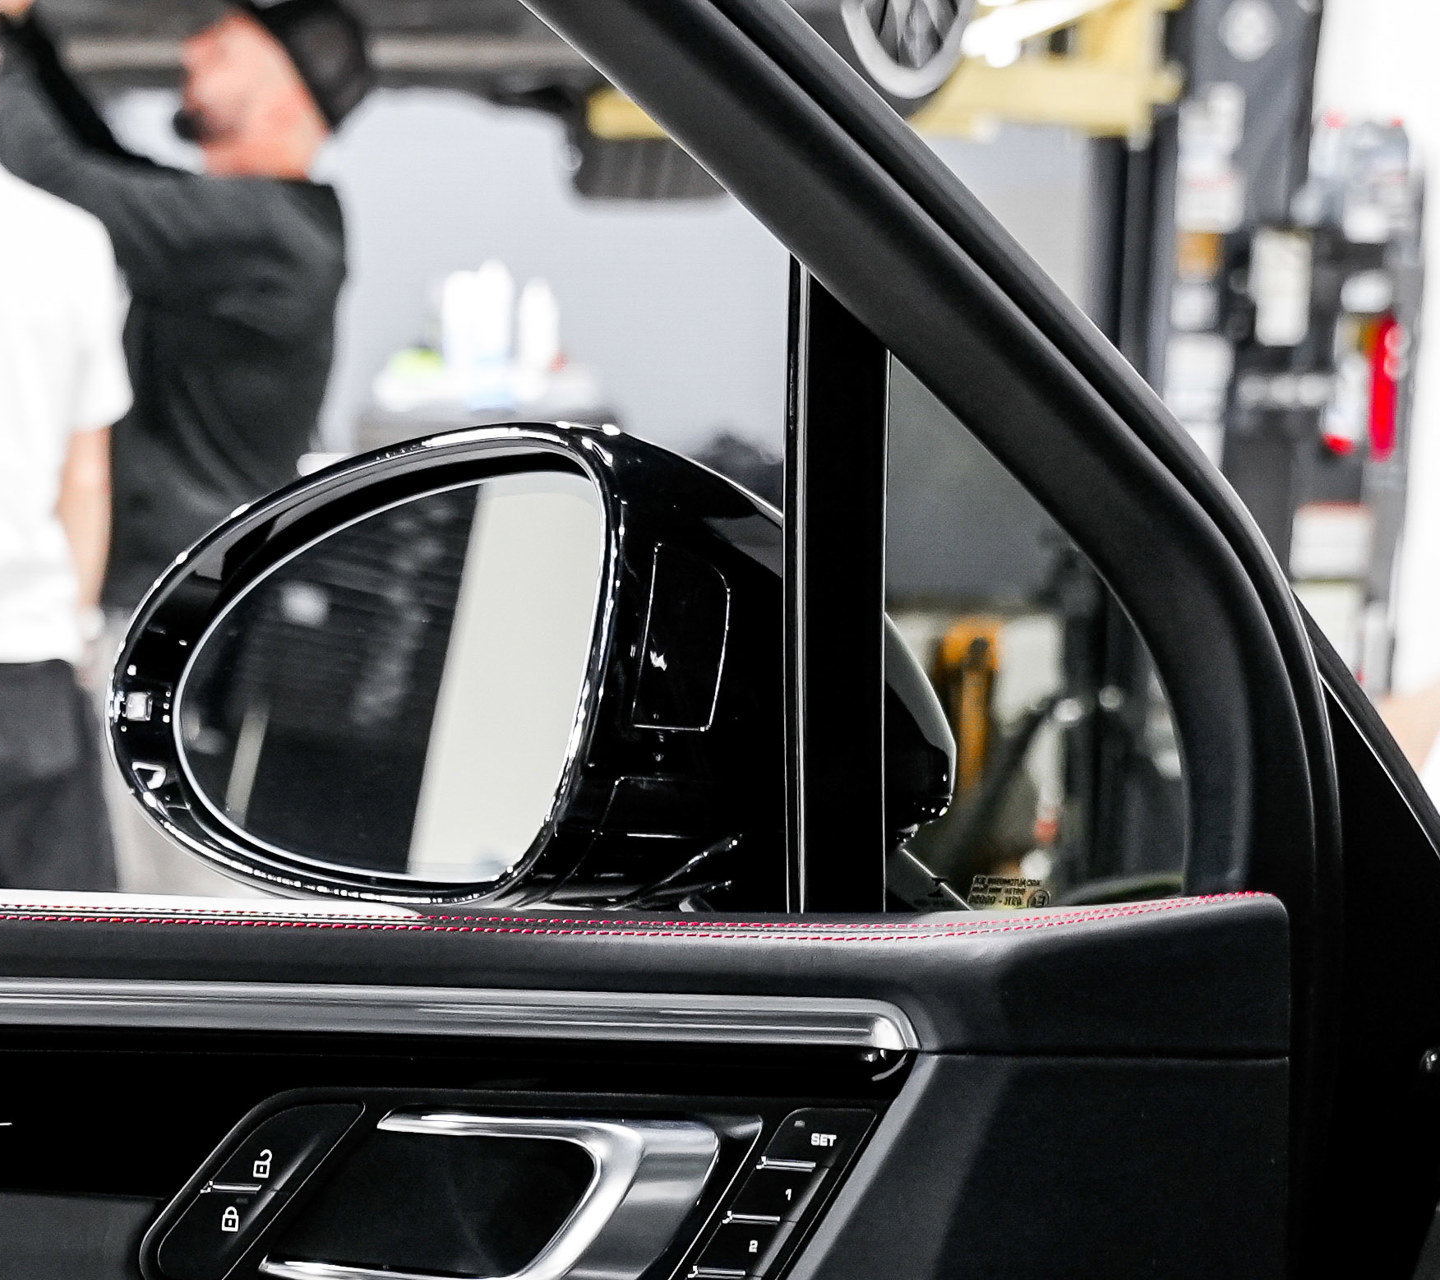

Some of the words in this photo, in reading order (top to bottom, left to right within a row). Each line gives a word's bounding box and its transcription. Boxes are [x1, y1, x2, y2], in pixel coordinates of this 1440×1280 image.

[810, 1132, 837, 1147] SET
[784, 1187, 793, 1201] 1
[748, 1239, 759, 1253] 2
